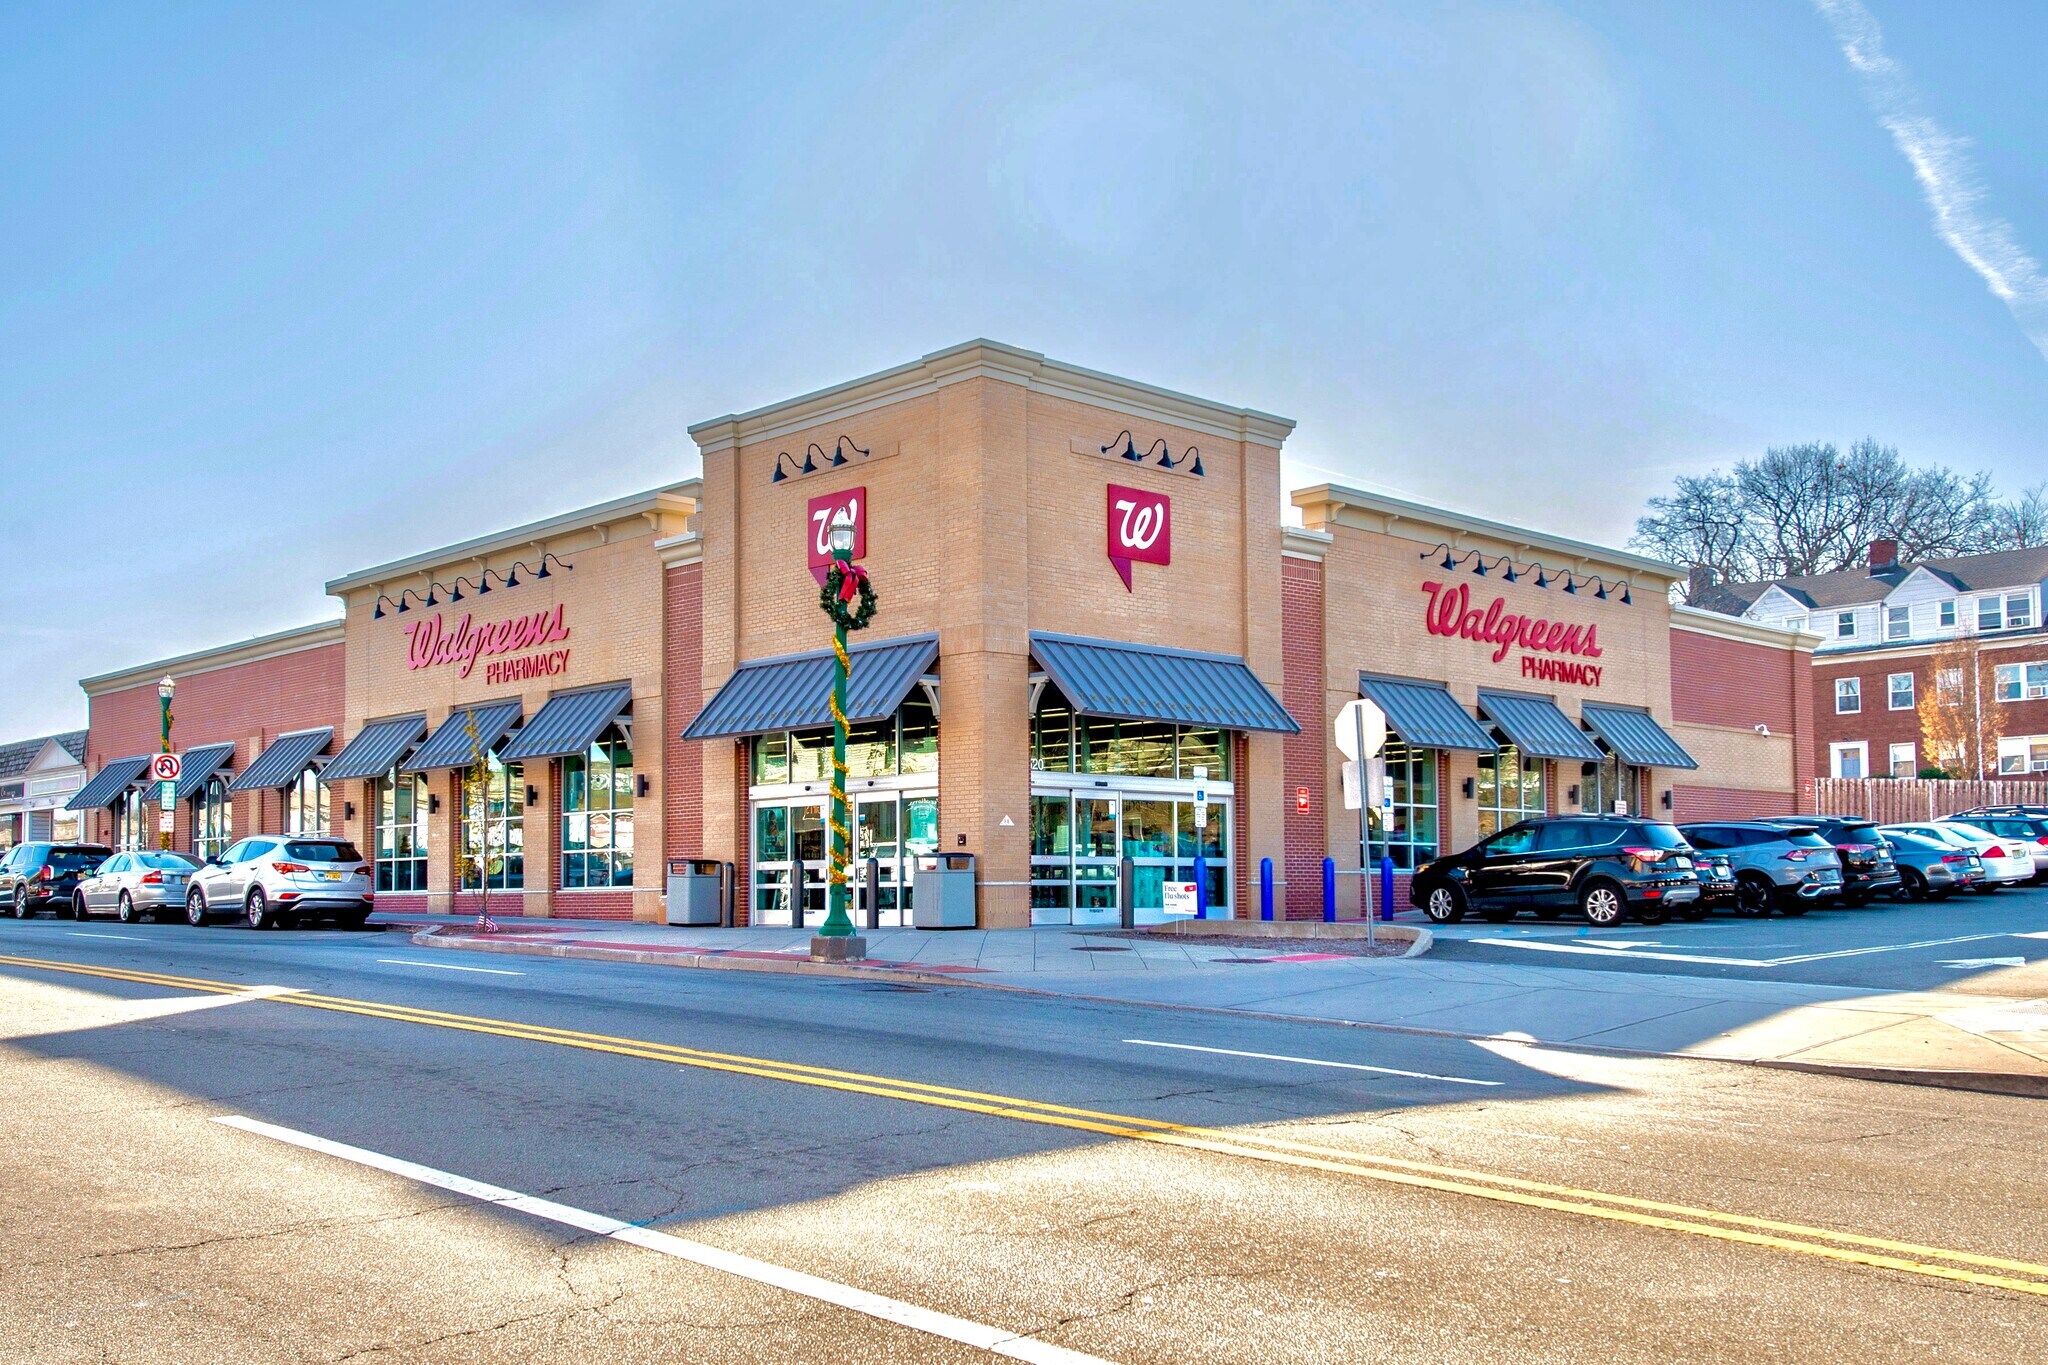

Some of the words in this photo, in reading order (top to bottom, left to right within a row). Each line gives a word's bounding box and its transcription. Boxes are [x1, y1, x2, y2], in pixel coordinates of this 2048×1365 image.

[1115, 500, 1164, 549] W
[404, 604, 569, 679] Walgreens
[1422, 581, 1602, 663] Walgreens
[486, 649, 570, 685] PHARMACY
[1522, 656, 1602, 687] PHARMACY
[1174, 892, 1190, 900] shots
